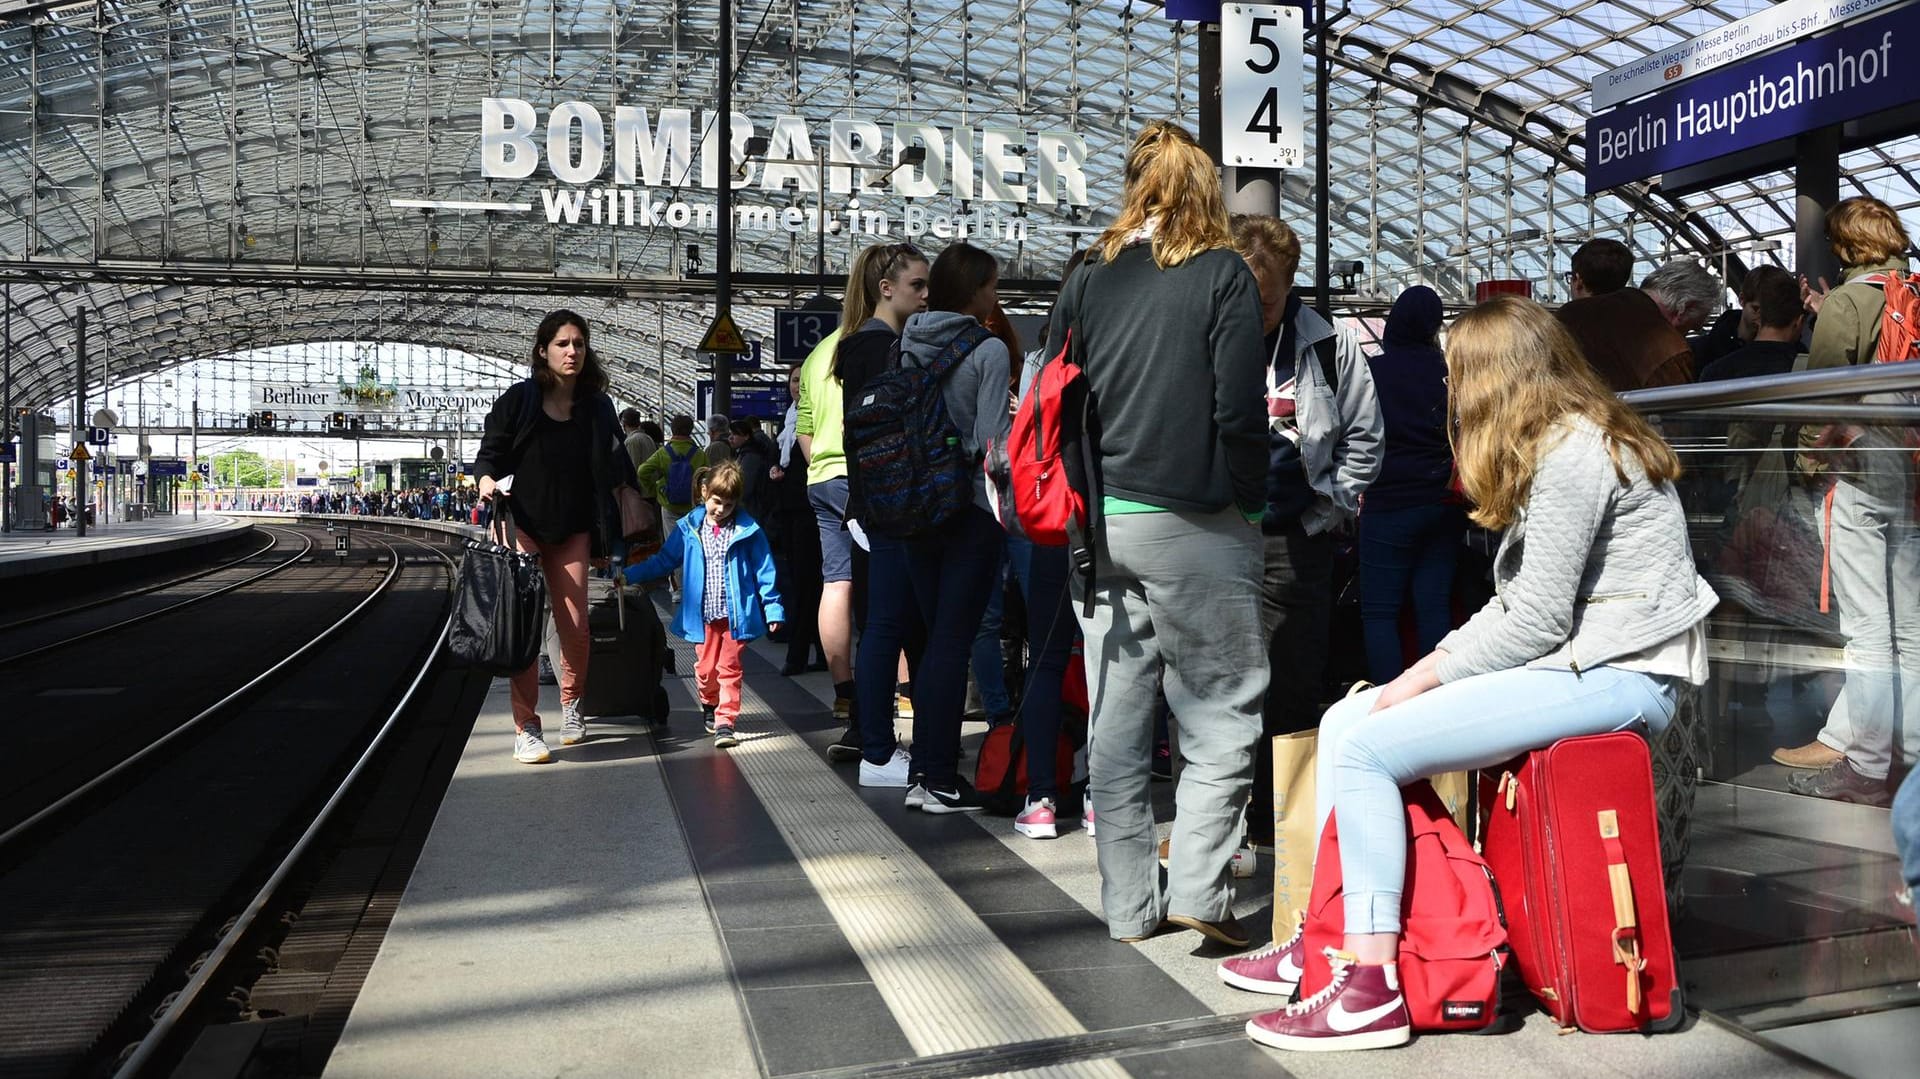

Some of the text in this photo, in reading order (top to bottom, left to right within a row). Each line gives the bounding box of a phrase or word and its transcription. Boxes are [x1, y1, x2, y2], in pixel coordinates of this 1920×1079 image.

[1245, 17, 1280, 74] 5
[1609, 23, 1750, 86] Der schnellste Weg zur Messe Berlin
[1695, 48, 1733, 69] Richtung
[1735, 32, 1774, 57] Spandau
[1776, 24, 1790, 40] bis
[1791, 12, 1821, 35] S-Bhf.
[1245, 87, 1282, 144] 4
[1598, 31, 1892, 166] Berlin Hauptbahnhof
[481, 97, 1089, 206] BOMBARDIER
[541, 188, 1028, 241] Willkommen in Berlin
[786, 315, 823, 350] 13
[262, 387, 496, 413] Berliner Morgenpost
[95, 428, 107, 442] D
[57, 459, 65, 469] C
[201, 463, 209, 472] C
[448, 464, 455, 473] C
[337, 536, 346, 549] H
